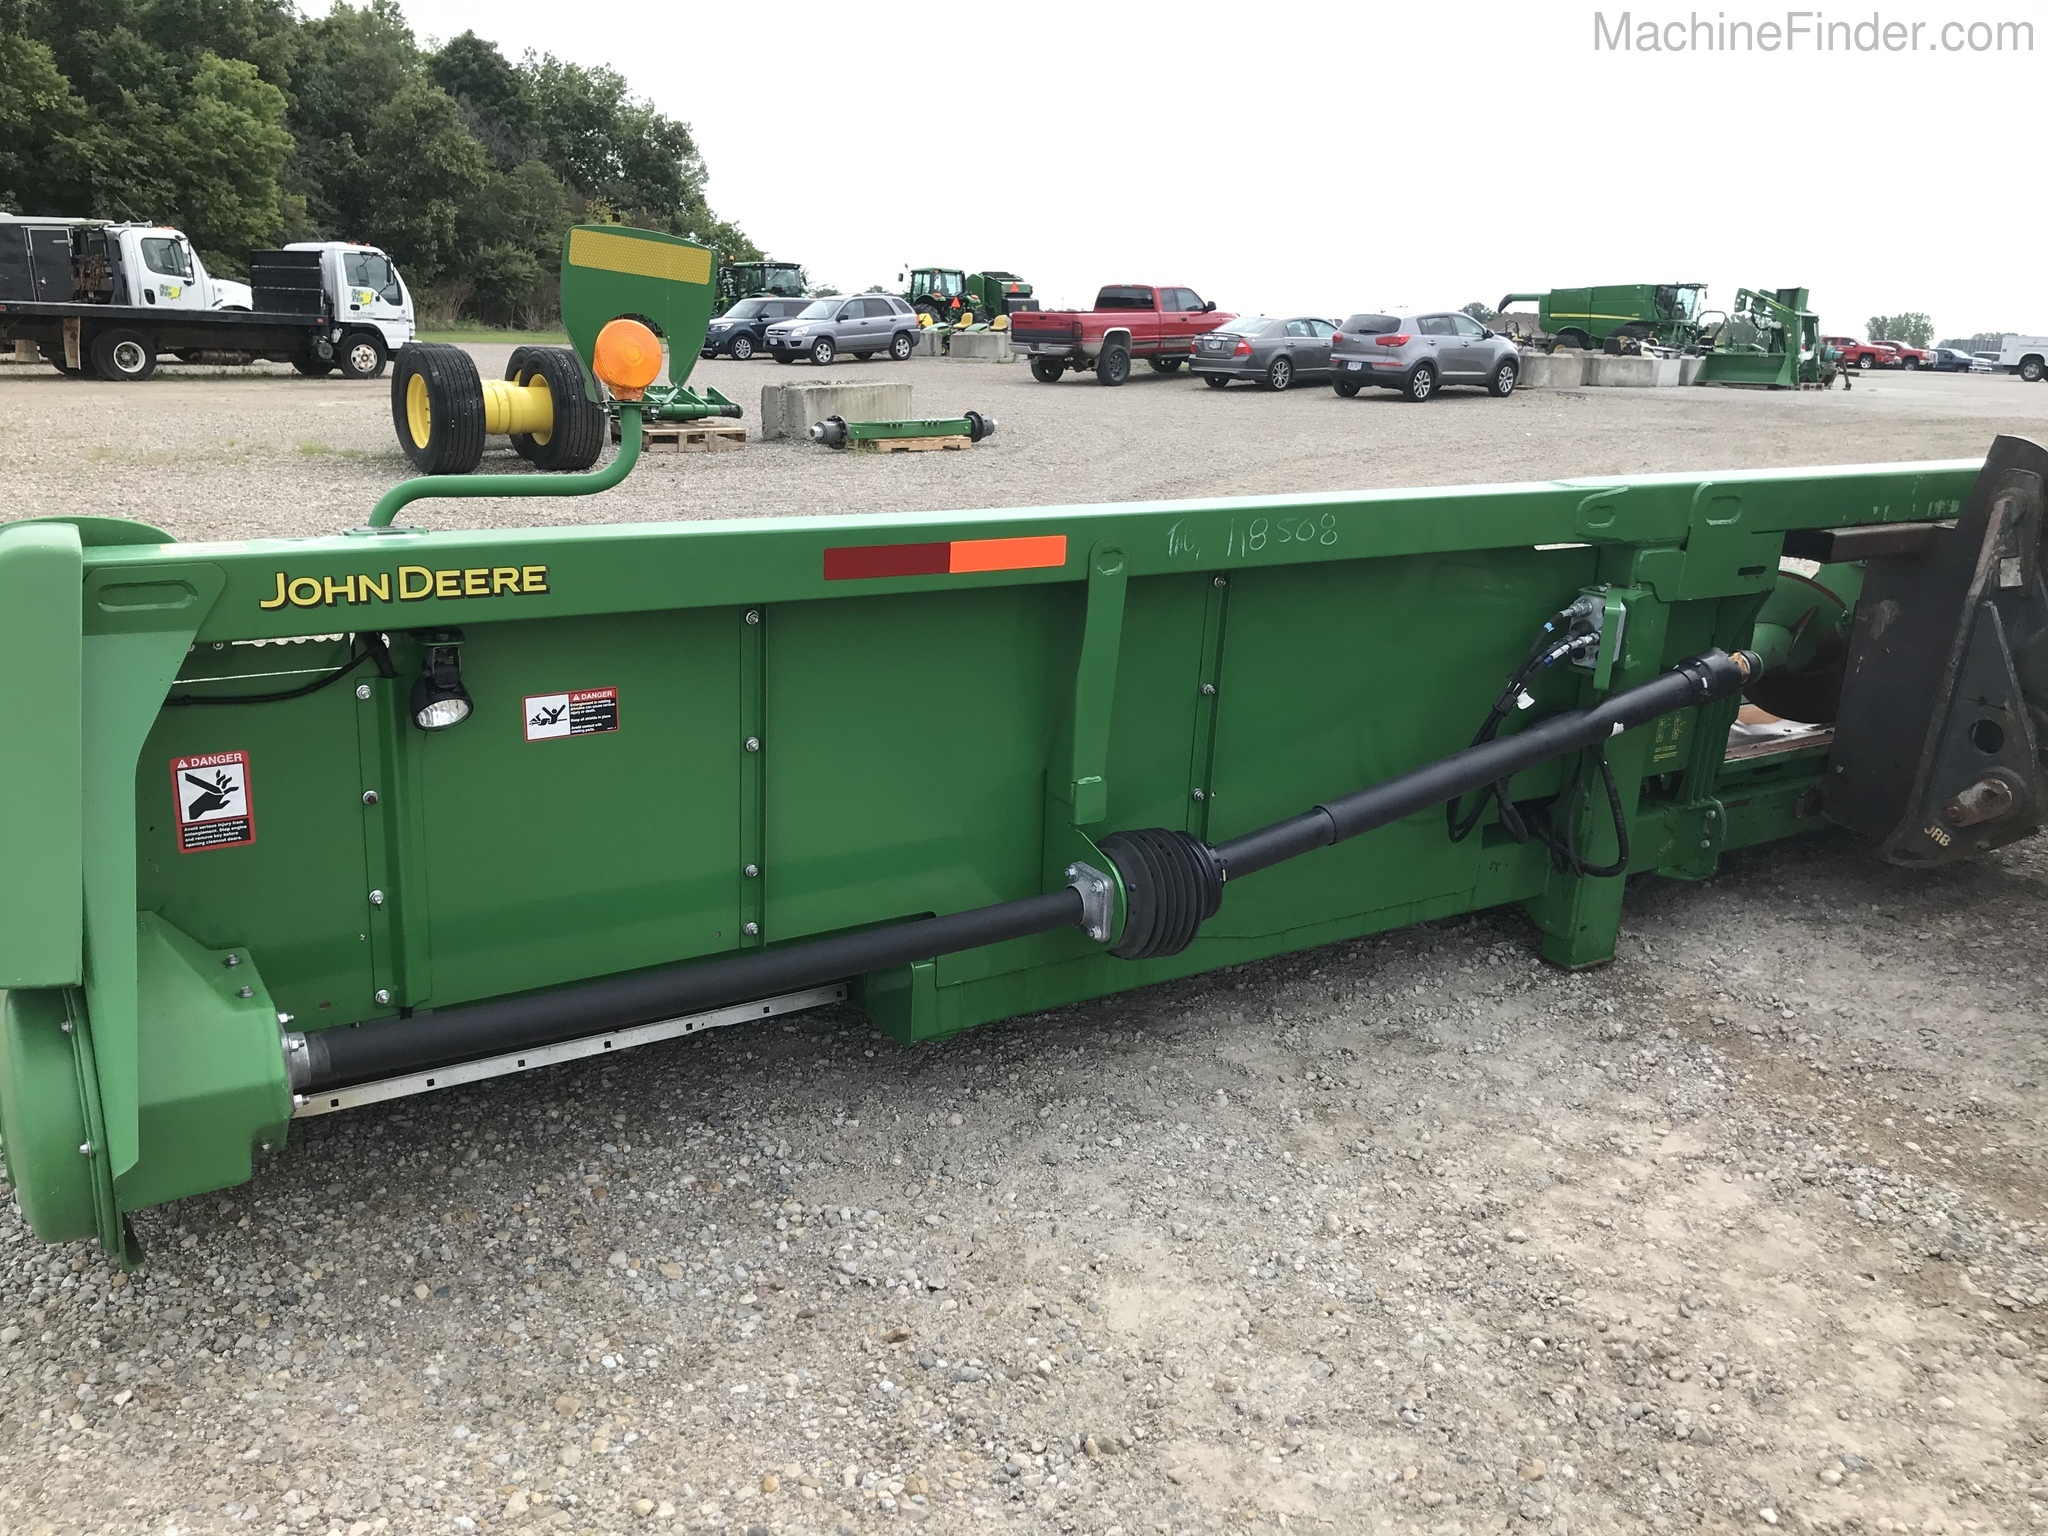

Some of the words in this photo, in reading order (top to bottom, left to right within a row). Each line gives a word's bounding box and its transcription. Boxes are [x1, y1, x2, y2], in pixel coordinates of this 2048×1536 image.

[259, 572, 392, 609] JOHN
[398, 565, 549, 602] DEERE
[582, 691, 612, 699] DANGER
[191, 753, 242, 766] DANGER
